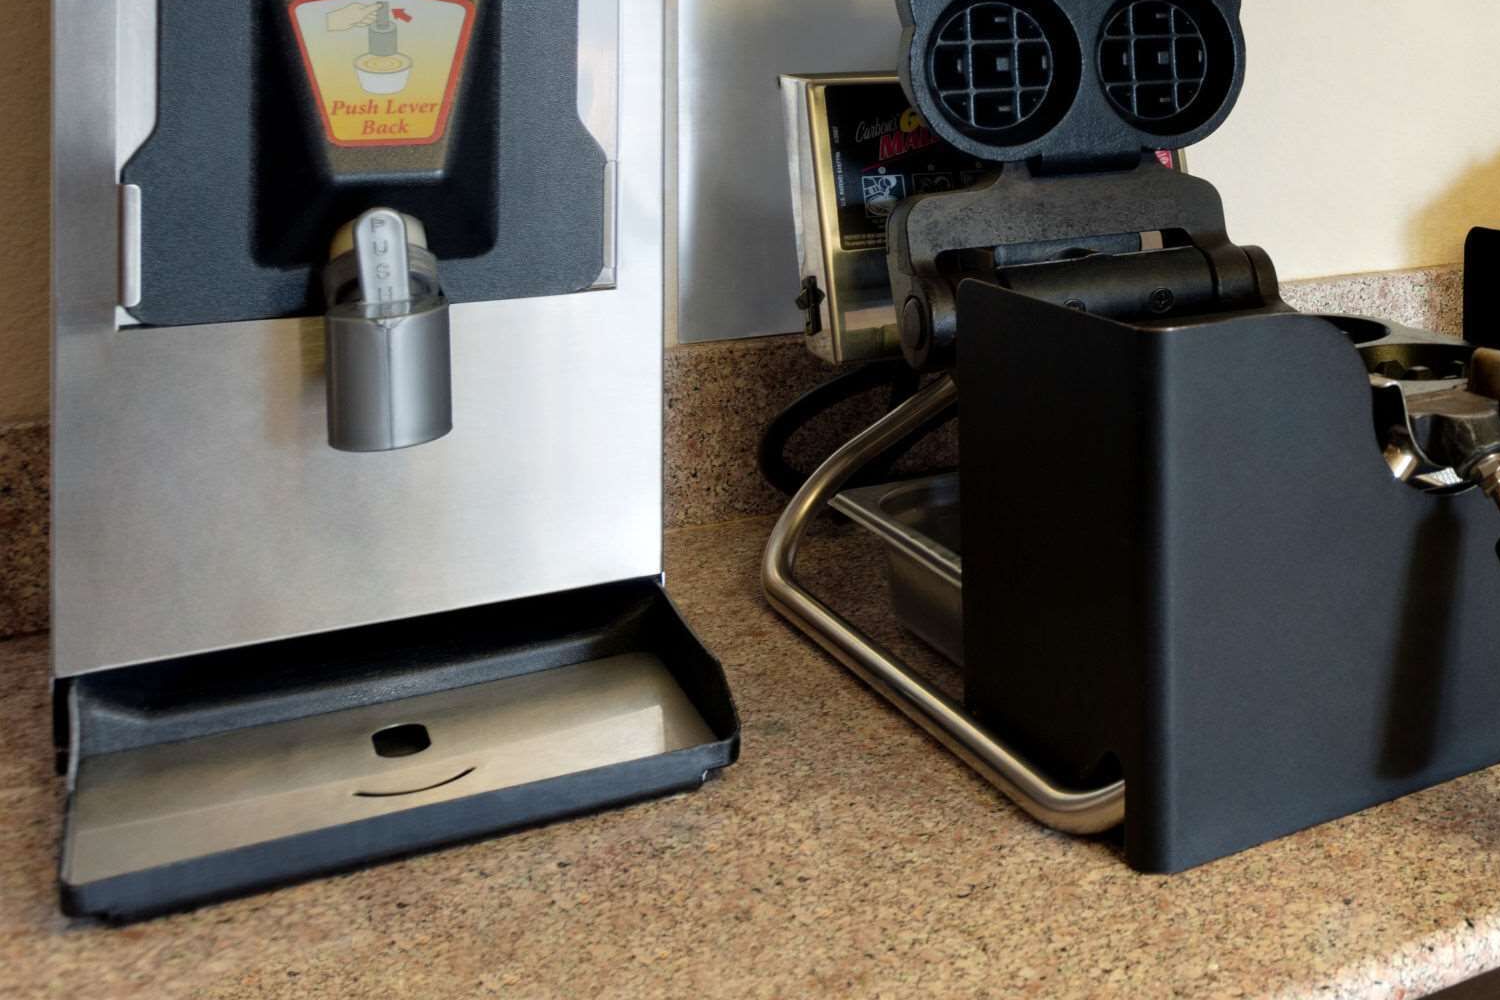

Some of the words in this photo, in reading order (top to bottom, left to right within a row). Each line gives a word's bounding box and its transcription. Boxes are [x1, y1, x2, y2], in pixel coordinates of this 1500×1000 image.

[331, 98, 380, 117] Push
[386, 99, 440, 114] Lever
[361, 119, 410, 136] Back
